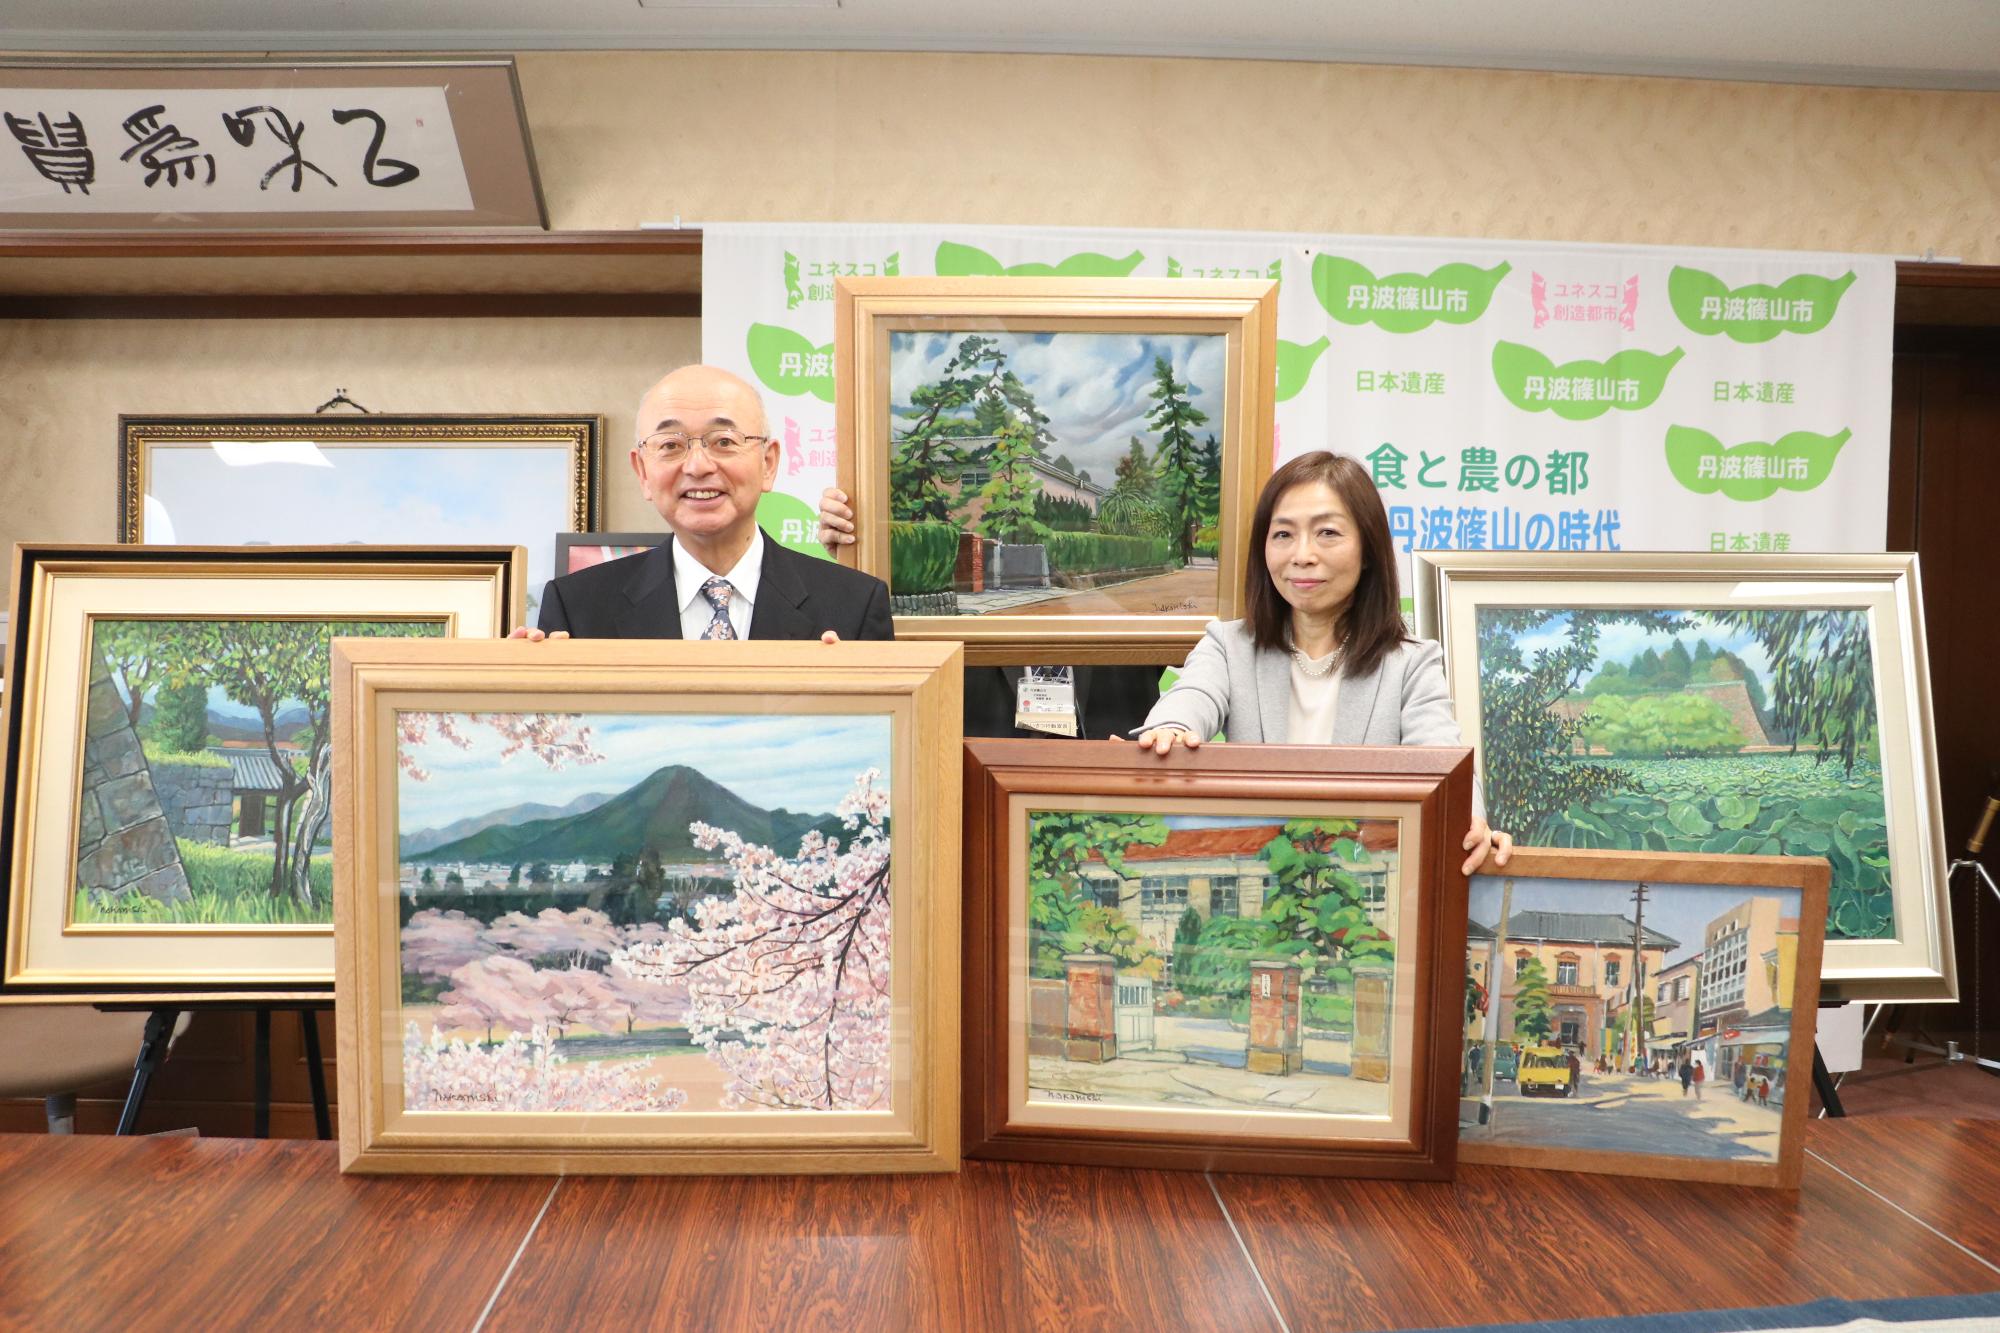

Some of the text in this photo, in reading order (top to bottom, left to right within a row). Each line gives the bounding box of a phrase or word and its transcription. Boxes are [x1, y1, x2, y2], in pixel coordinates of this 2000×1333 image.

[807, 262, 877, 277] ユネスコ
[1347, 284, 1469, 313] 丹波篠山市
[1553, 282, 1618, 299] ユネスコ
[1554, 303, 1618, 321] 創造都市
[1700, 296, 1815, 322] 丹波篠山市
[779, 352, 835, 378] 丹波
[1356, 370, 1446, 395] 日本遺産
[1524, 376, 1640, 402] 丹波篠山市
[1713, 380, 1795, 404] 日本遺産
[1365, 442, 1590, 496] 食と農の都
[1697, 455, 1810, 480] 丹波篠山市
[1389, 505, 1622, 554] 丹波篠山の時代
[1710, 531, 1792, 552] 日本遺産
